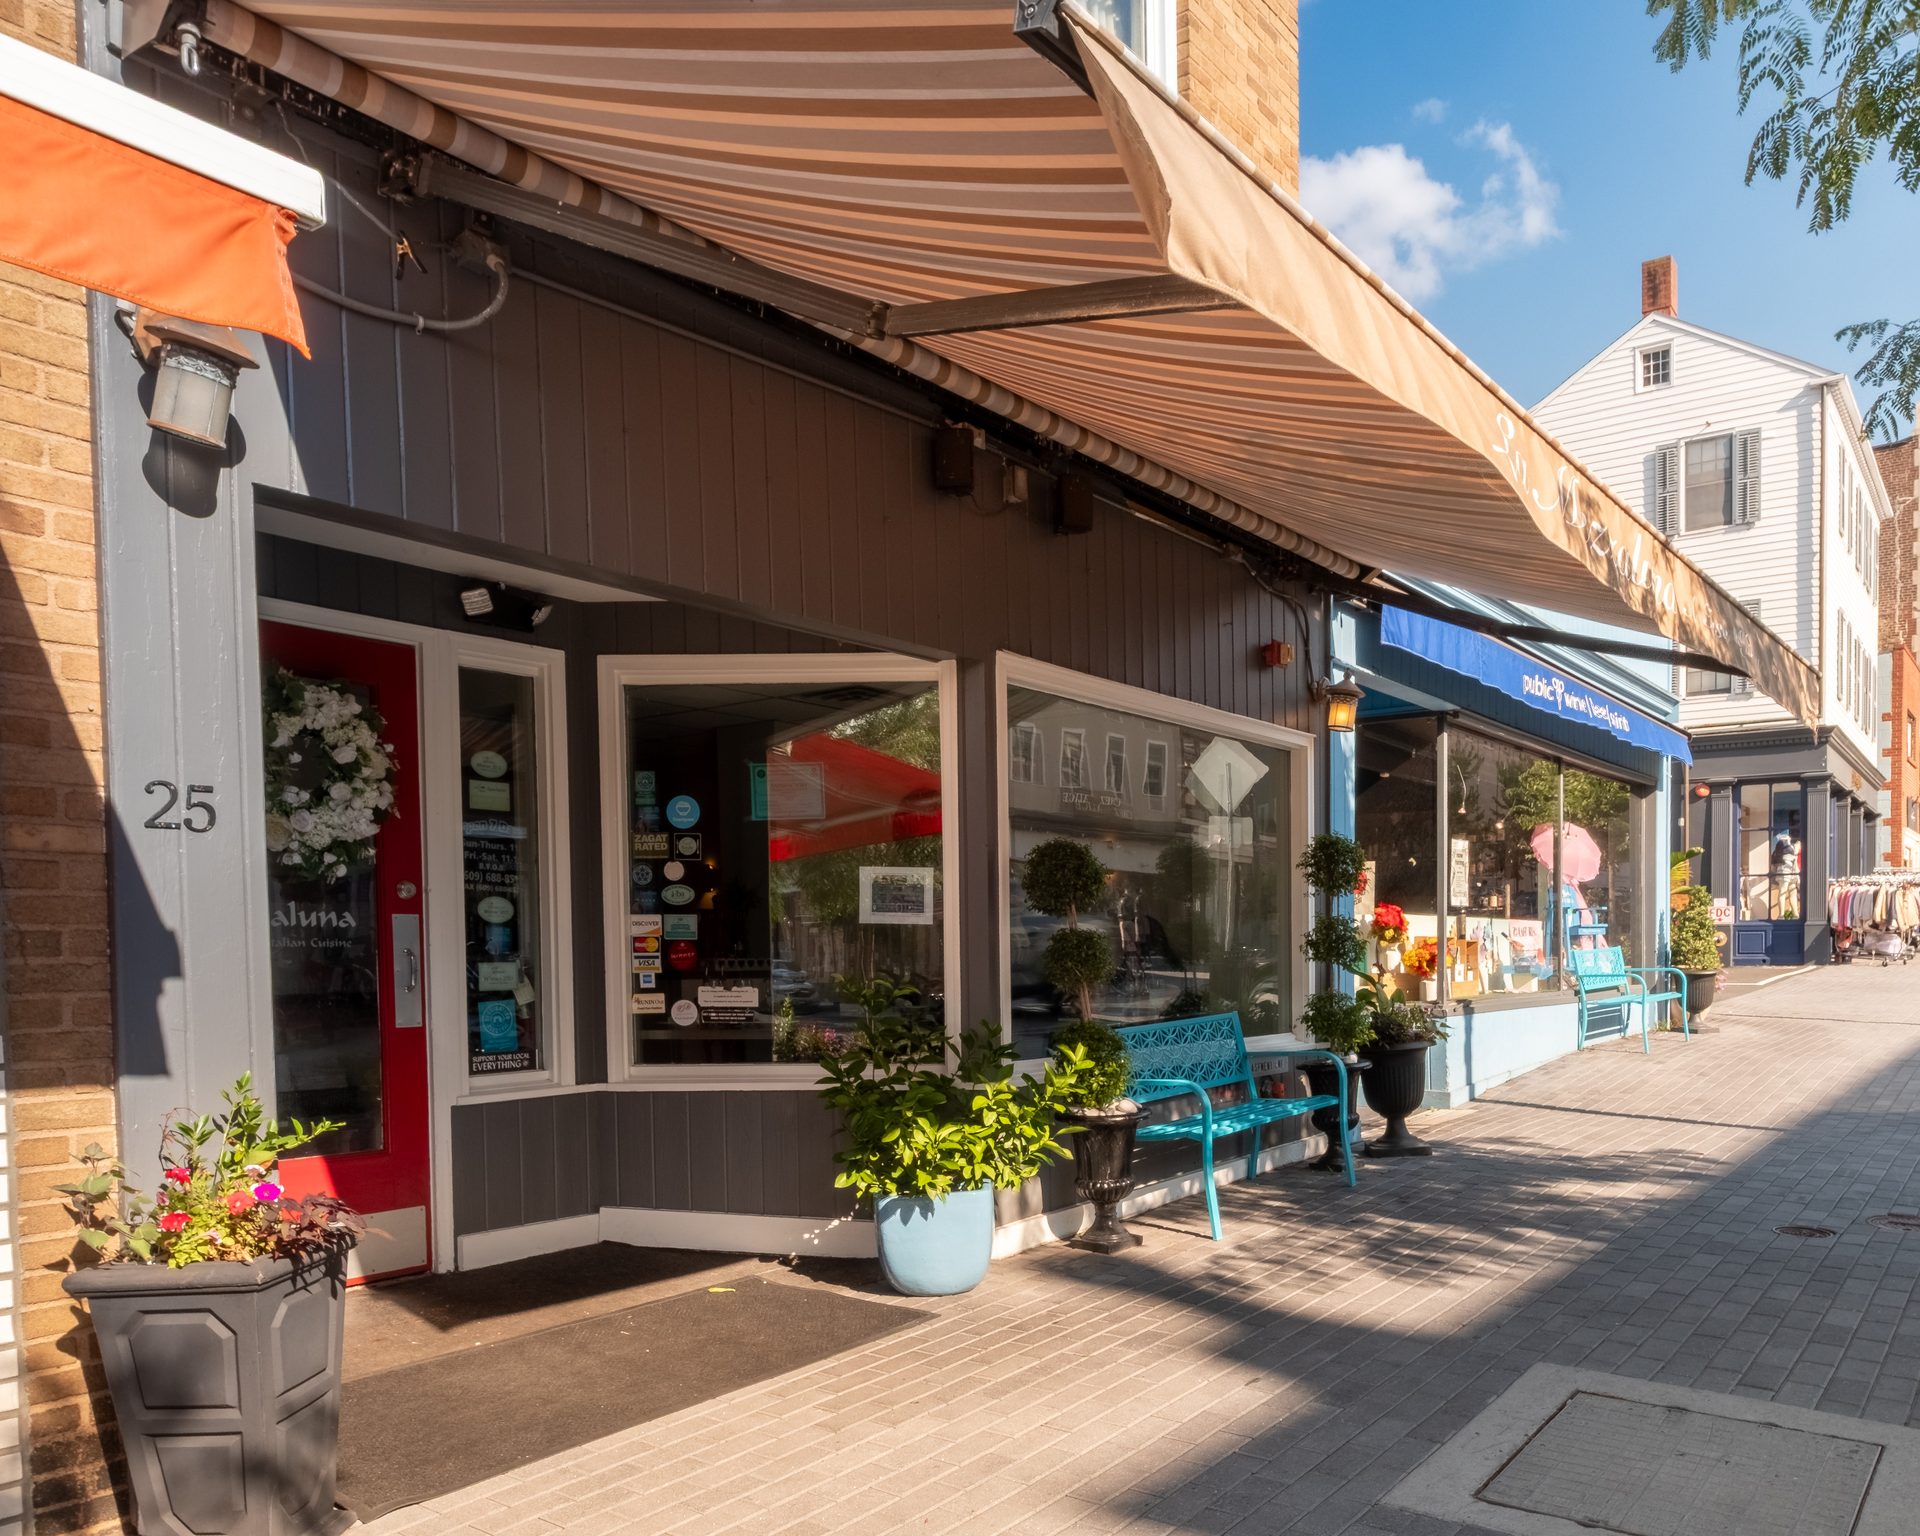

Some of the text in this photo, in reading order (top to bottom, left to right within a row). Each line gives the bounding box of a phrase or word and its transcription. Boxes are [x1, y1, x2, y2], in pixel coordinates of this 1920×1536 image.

[1523, 675, 1554, 701] public
[144, 780, 216, 833] 25
[634, 833, 668, 843] ZAGAT
[634, 843, 668, 851] RATED
[310, 937, 352, 948] Cuisine
[472, 1060, 522, 1071] EVERYTHING
